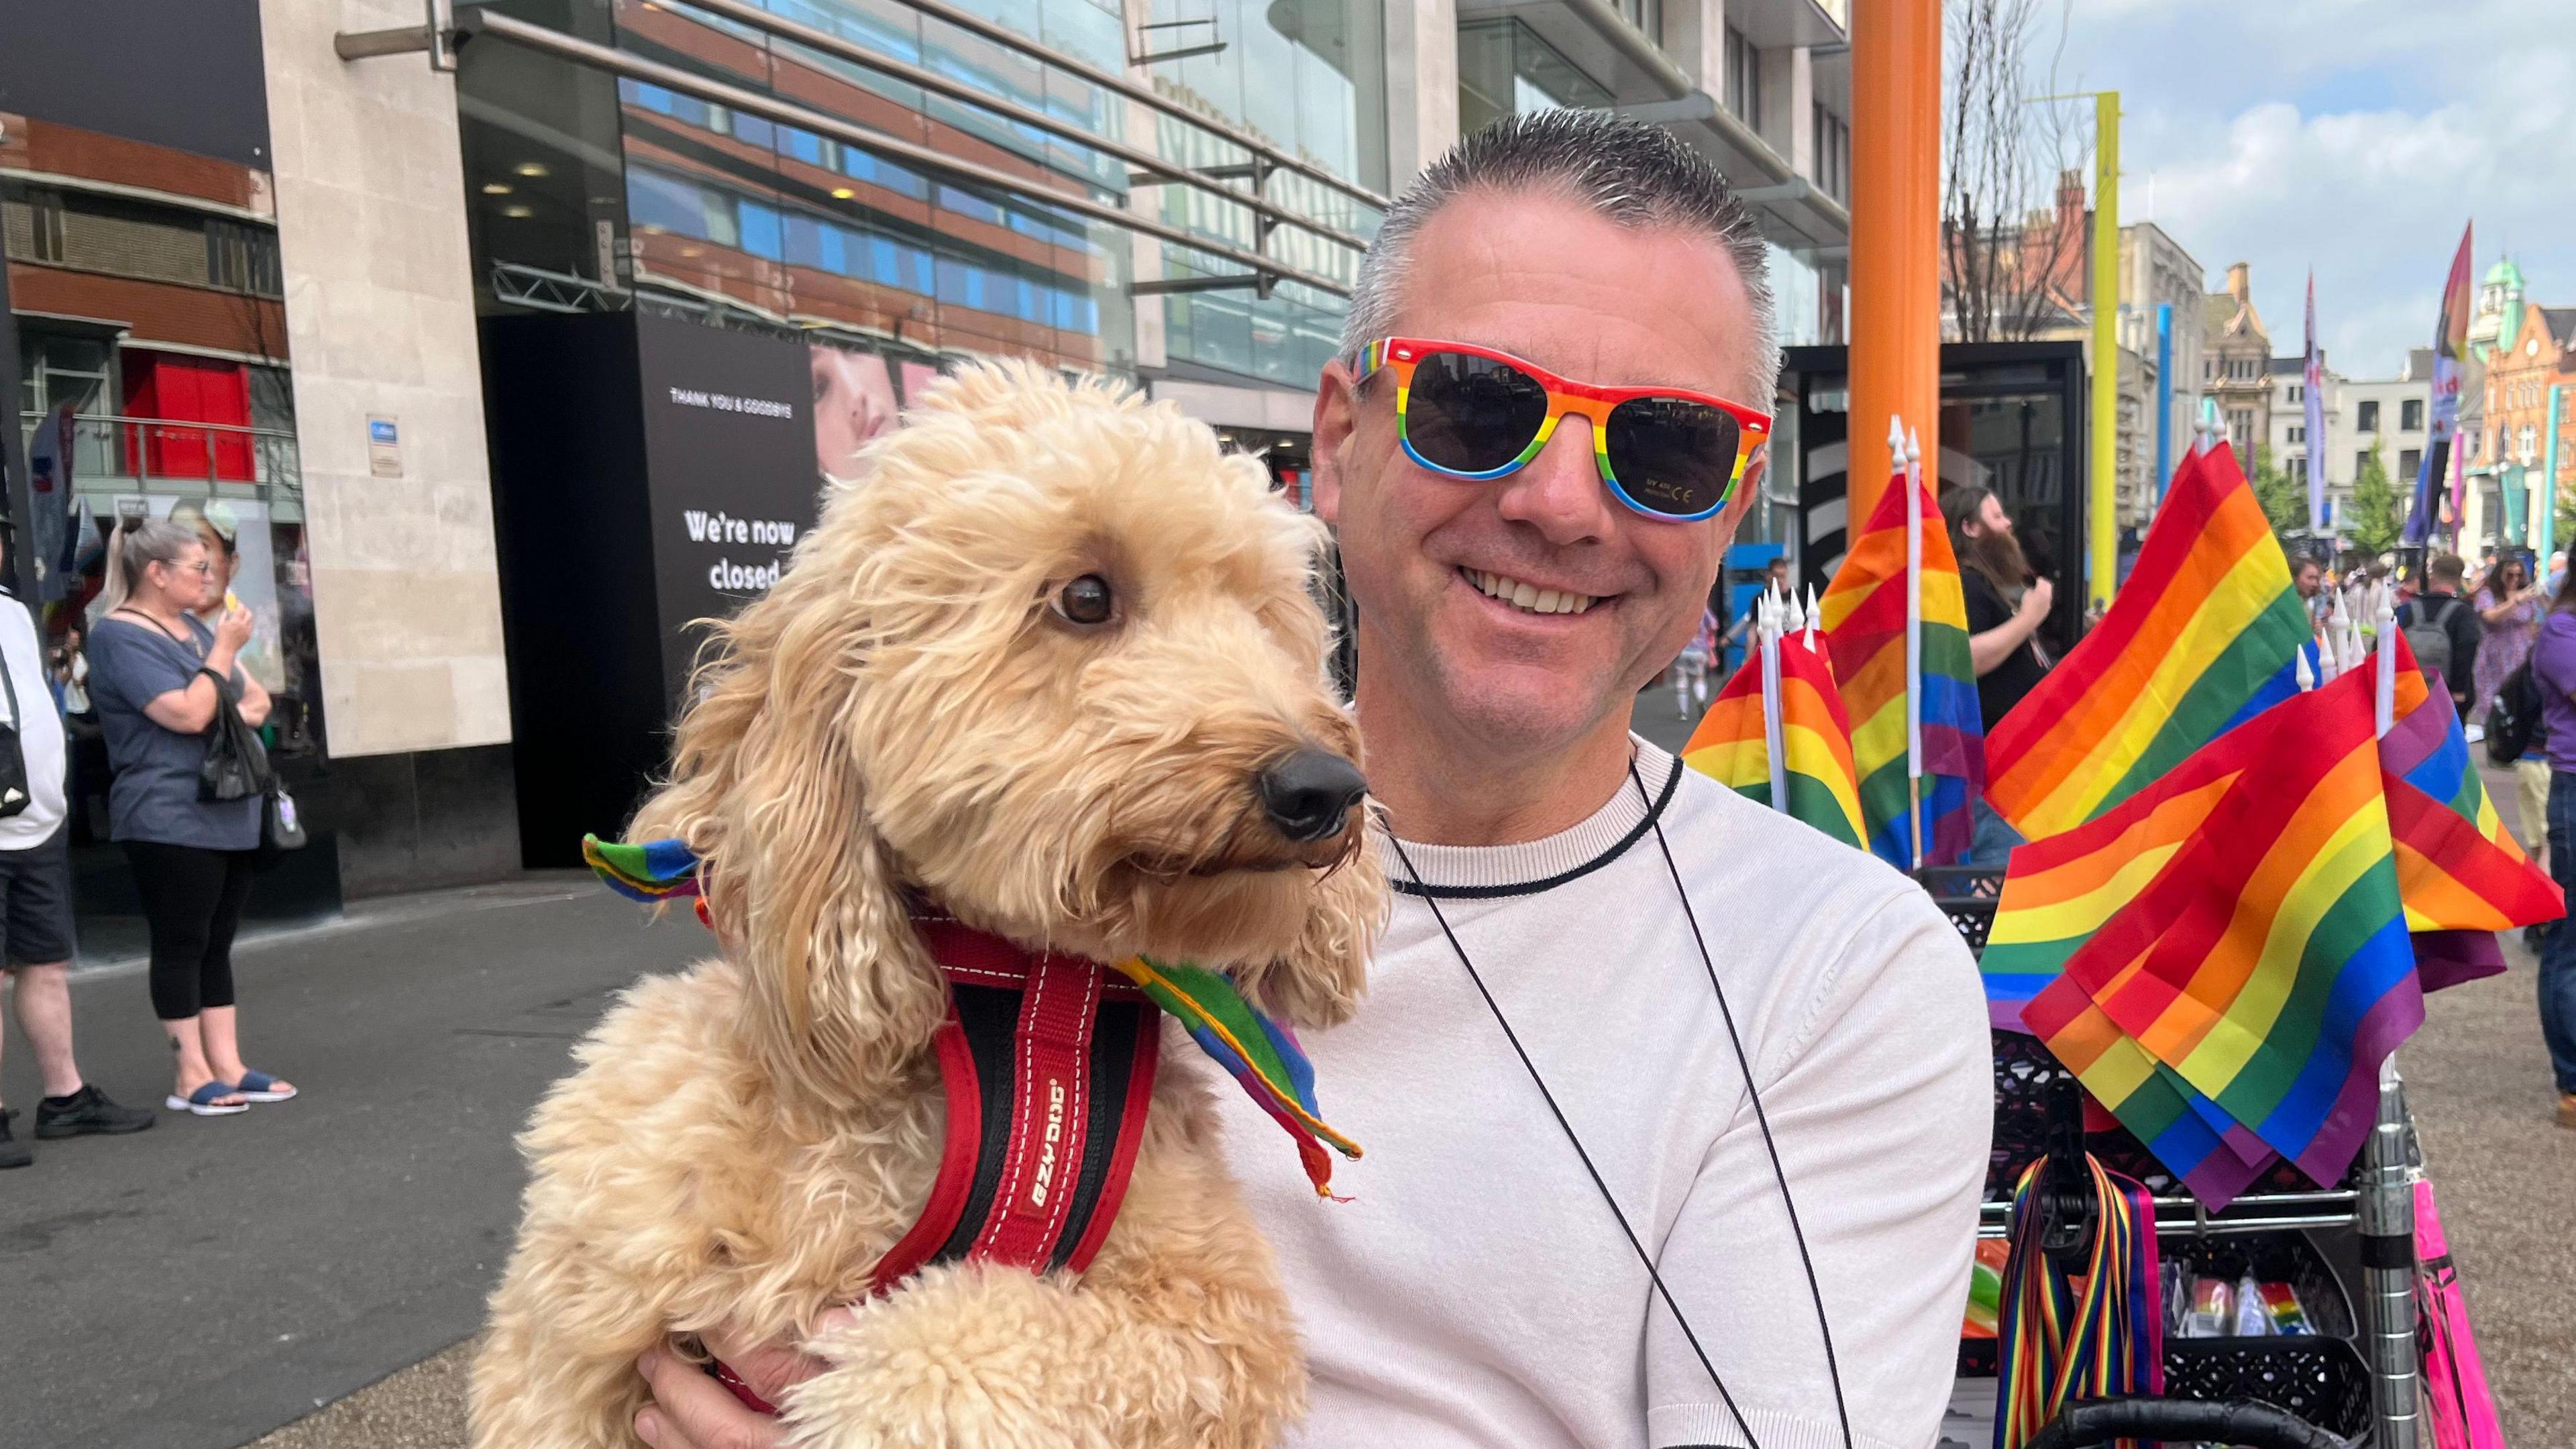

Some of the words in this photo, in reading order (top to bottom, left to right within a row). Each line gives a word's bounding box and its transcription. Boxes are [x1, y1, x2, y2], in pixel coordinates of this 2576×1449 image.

[669, 386, 709, 408] THANK
[709, 392, 734, 411] YOU
[734, 396, 743, 413] &
[743, 397, 793, 419] GOODBYE
[1671, 486, 1694, 504] CE
[683, 509, 749, 544] We're
[751, 519, 796, 545] now
[709, 557, 780, 590] closed
